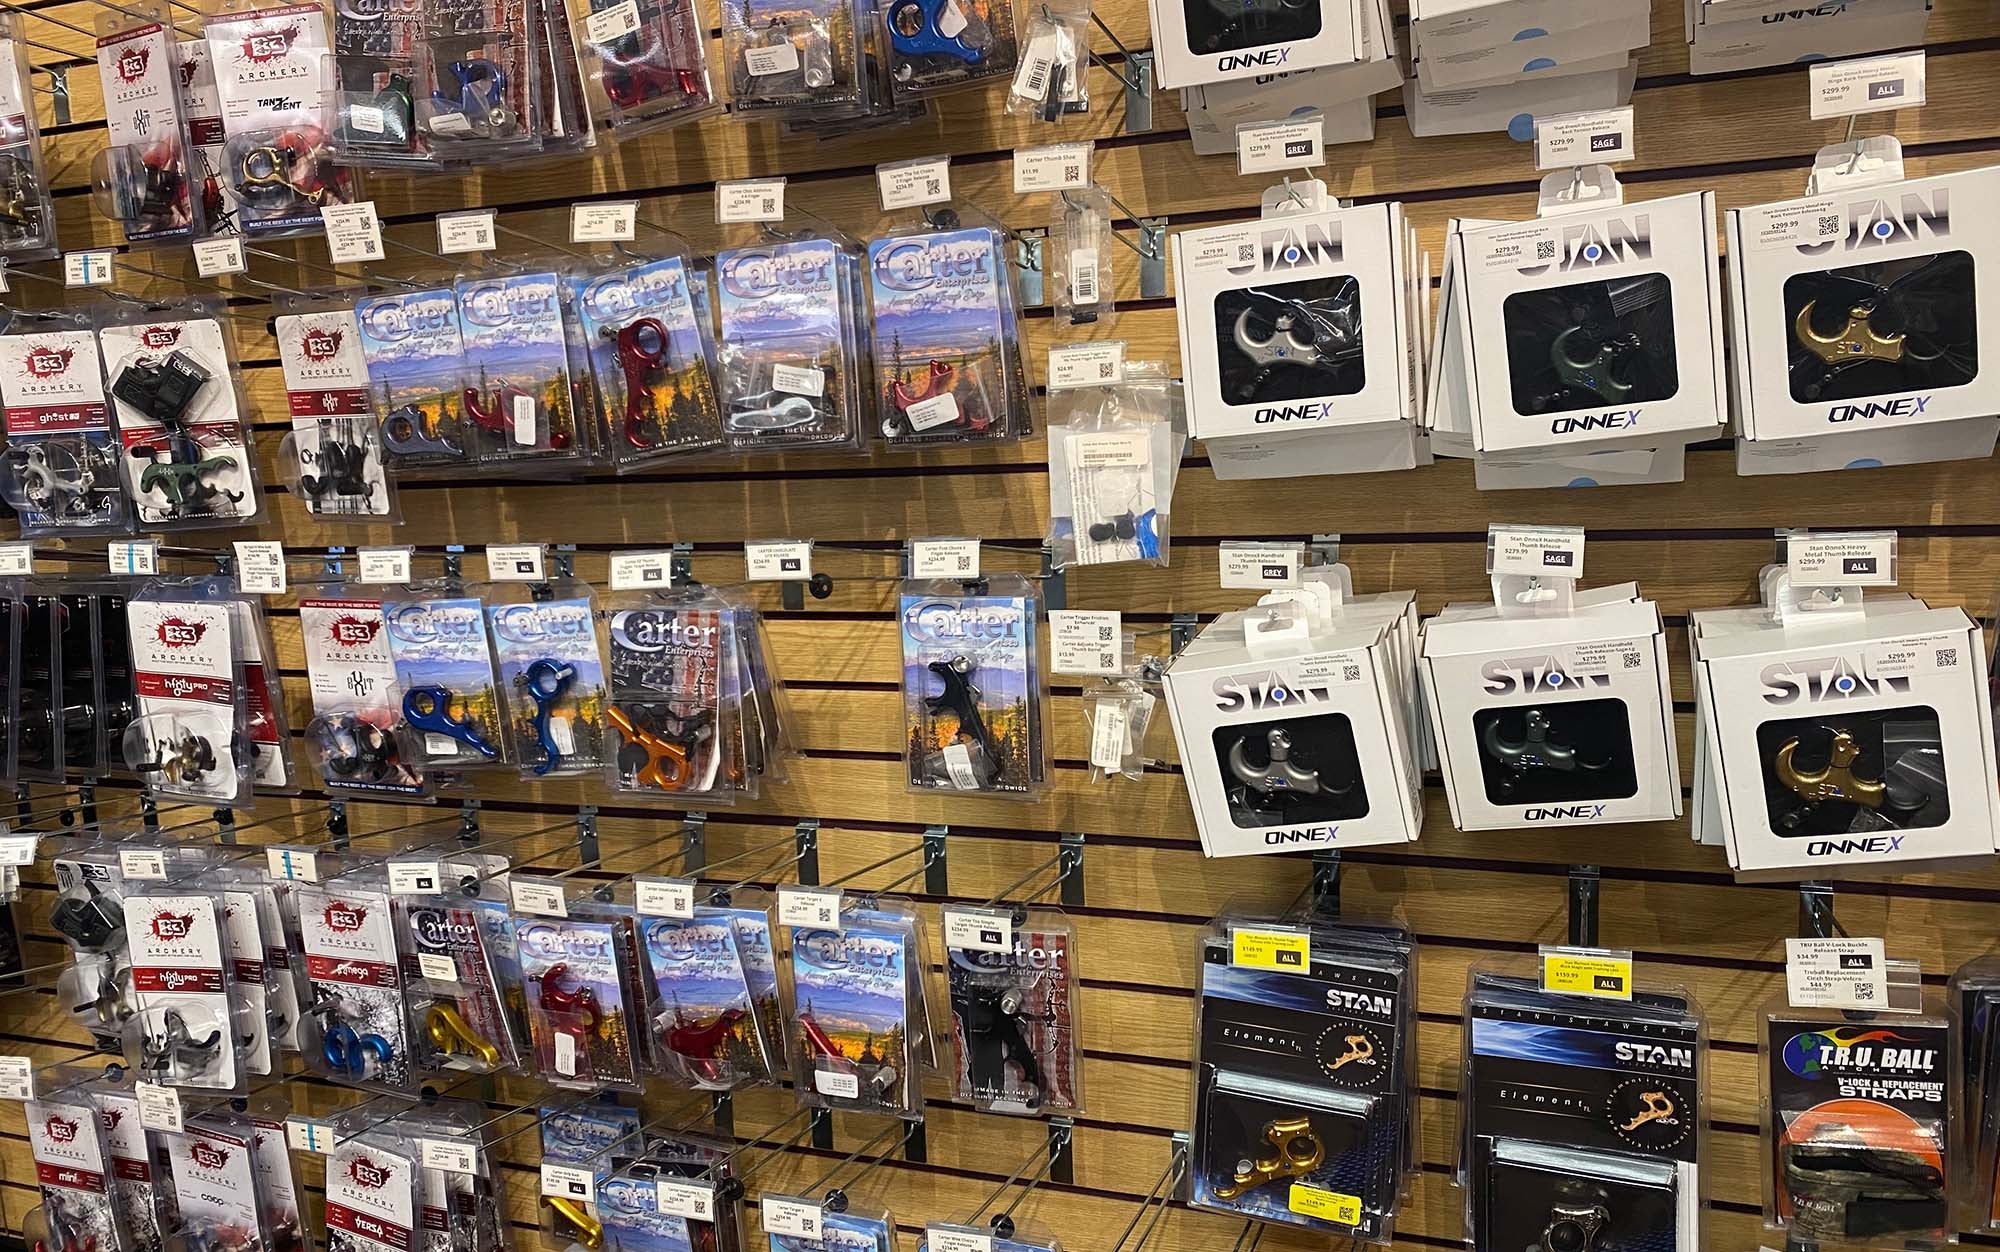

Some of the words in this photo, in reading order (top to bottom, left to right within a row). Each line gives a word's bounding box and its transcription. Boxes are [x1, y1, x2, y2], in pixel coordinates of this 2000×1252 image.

[238, 66, 309, 82] ARCHERY
[117, 86, 158, 101] ARCHERY
[1822, 86, 1850, 95] $299.99
[1877, 84, 1896, 96] ALL
[1286, 144, 1306, 154] GREY
[1593, 138, 1614, 148] SAGE
[1771, 221, 1799, 230] $299.99
[1495, 245, 1520, 254] $279.99
[874, 239, 989, 291] Carter
[721, 250, 832, 299] Carter
[462, 281, 553, 327] Carter
[582, 275, 683, 322] Carter
[360, 301, 453, 342] Carter
[300, 368, 351, 376] ARCHERY
[21, 382, 83, 394] ARCHERY
[1504, 547, 1528, 555] $279.99
[1847, 543, 1867, 552] Heavy
[1545, 554, 1566, 564] SAGE
[1851, 562, 1868, 571] ALL
[1263, 569, 1282, 577] GREY
[387, 605, 480, 644] Carter
[493, 605, 588, 644] Carter
[904, 600, 1020, 644] Carter
[610, 611, 717, 653] Carter
[151, 653, 213, 663] ARCHERY
[664, 645, 715, 659] Enterprises
[1887, 651, 1916, 660] $299.99
[410, 910, 476, 949] Carter
[319, 937, 376, 948] ARCHERY
[517, 923, 610, 960] Carter
[647, 920, 729, 960] Carter
[985, 934, 997, 942] ALL
[794, 931, 900, 970] Carter
[1281, 953, 1295, 963] ALL
[1847, 958, 1864, 967] ALL
[847, 965, 899, 977] Enterprises
[1600, 979, 1616, 989] ALL
[1326, 989, 1392, 1015] STAN
[1482, 1007, 1686, 1036] STANISLAWSKI
[1224, 1028, 1296, 1047] Element
[1616, 1042, 1692, 1068] STAN
[1819, 1045, 1875, 1067] T.R.U.
[1881, 1048, 1935, 1071] BALL
[1820, 1065, 1931, 1075] ARCHERY
[1837, 1076, 1871, 1088] V-LOCK
[1873, 1080, 1880, 1088] &
[1882, 1079, 1944, 1092] REPLACEMENT
[1500, 1089, 1583, 1108] Element
[1839, 1086, 1942, 1102] STRAPS
[43, 1146, 86, 1158] ARCHERY
[187, 1169, 237, 1188] ARCHERY
[343, 1187, 395, 1209] ARCHERY
